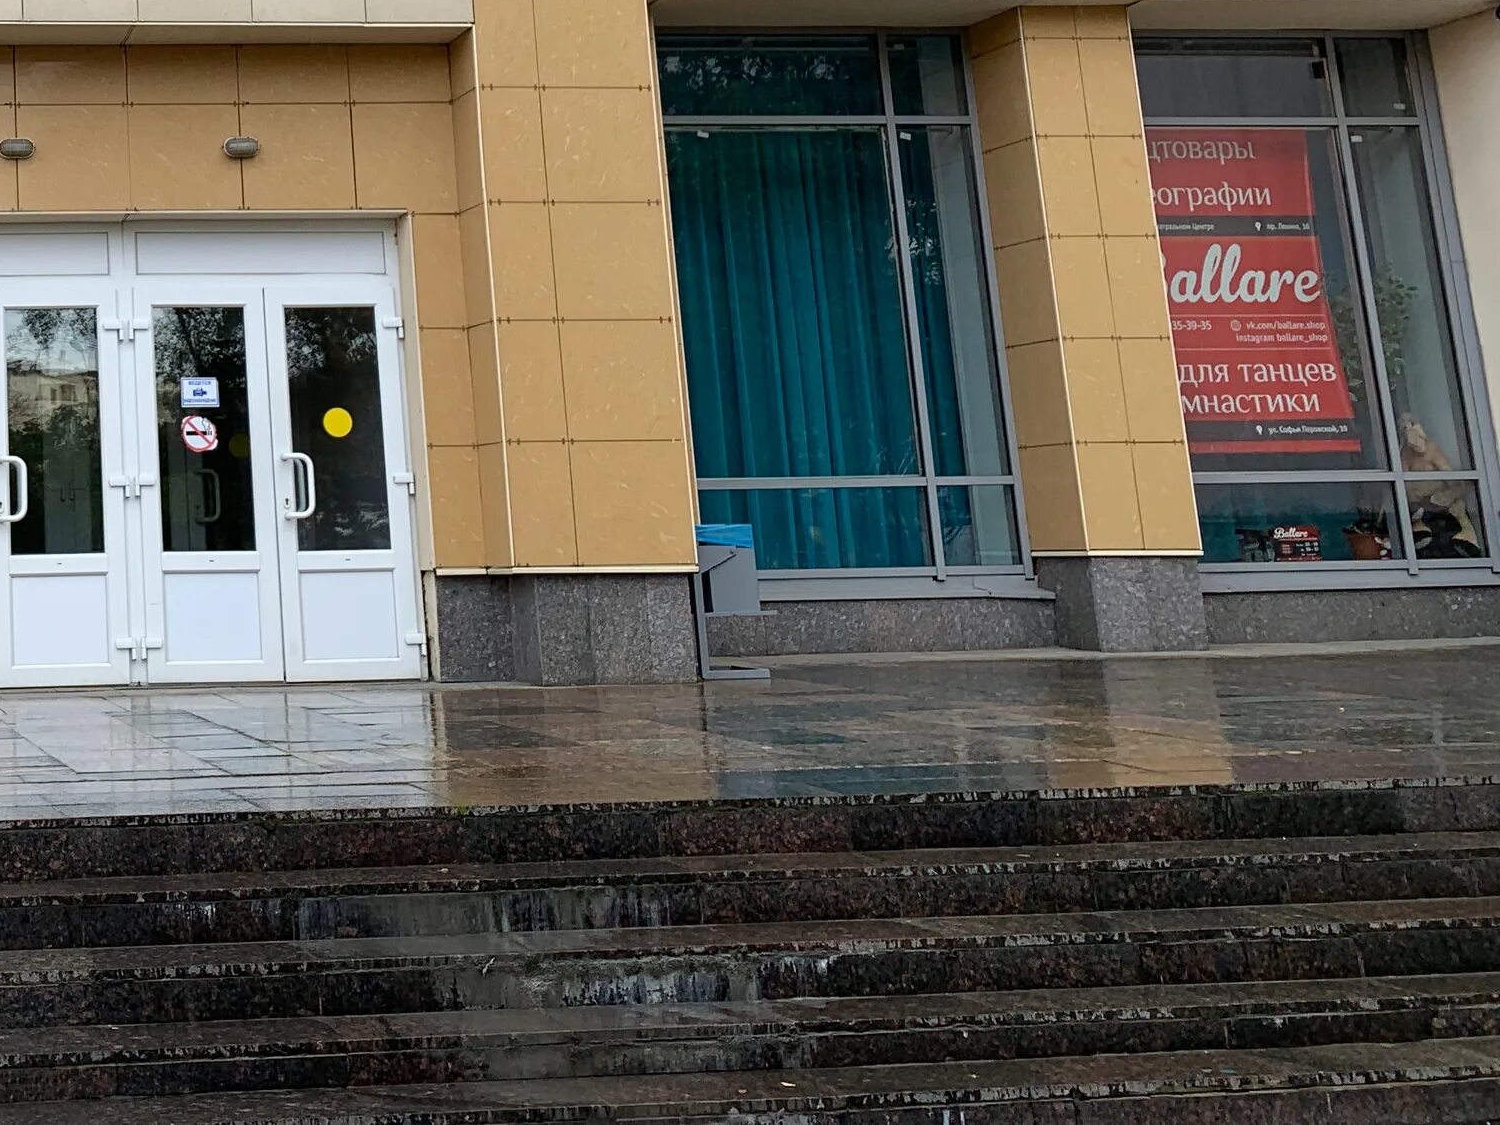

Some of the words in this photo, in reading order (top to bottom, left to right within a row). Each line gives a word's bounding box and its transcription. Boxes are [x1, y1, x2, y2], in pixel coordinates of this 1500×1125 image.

[1162, 242, 1322, 303] allare
[1246, 319, 1326, 332] vk.com/ballare.shop
[1235, 332, 1275, 345] instagram
[1276, 332, 1329, 345] ballare_shop
[1178, 363, 1229, 387] для
[1237, 363, 1337, 387] танцев
[1273, 527, 1308, 538] Ballare
